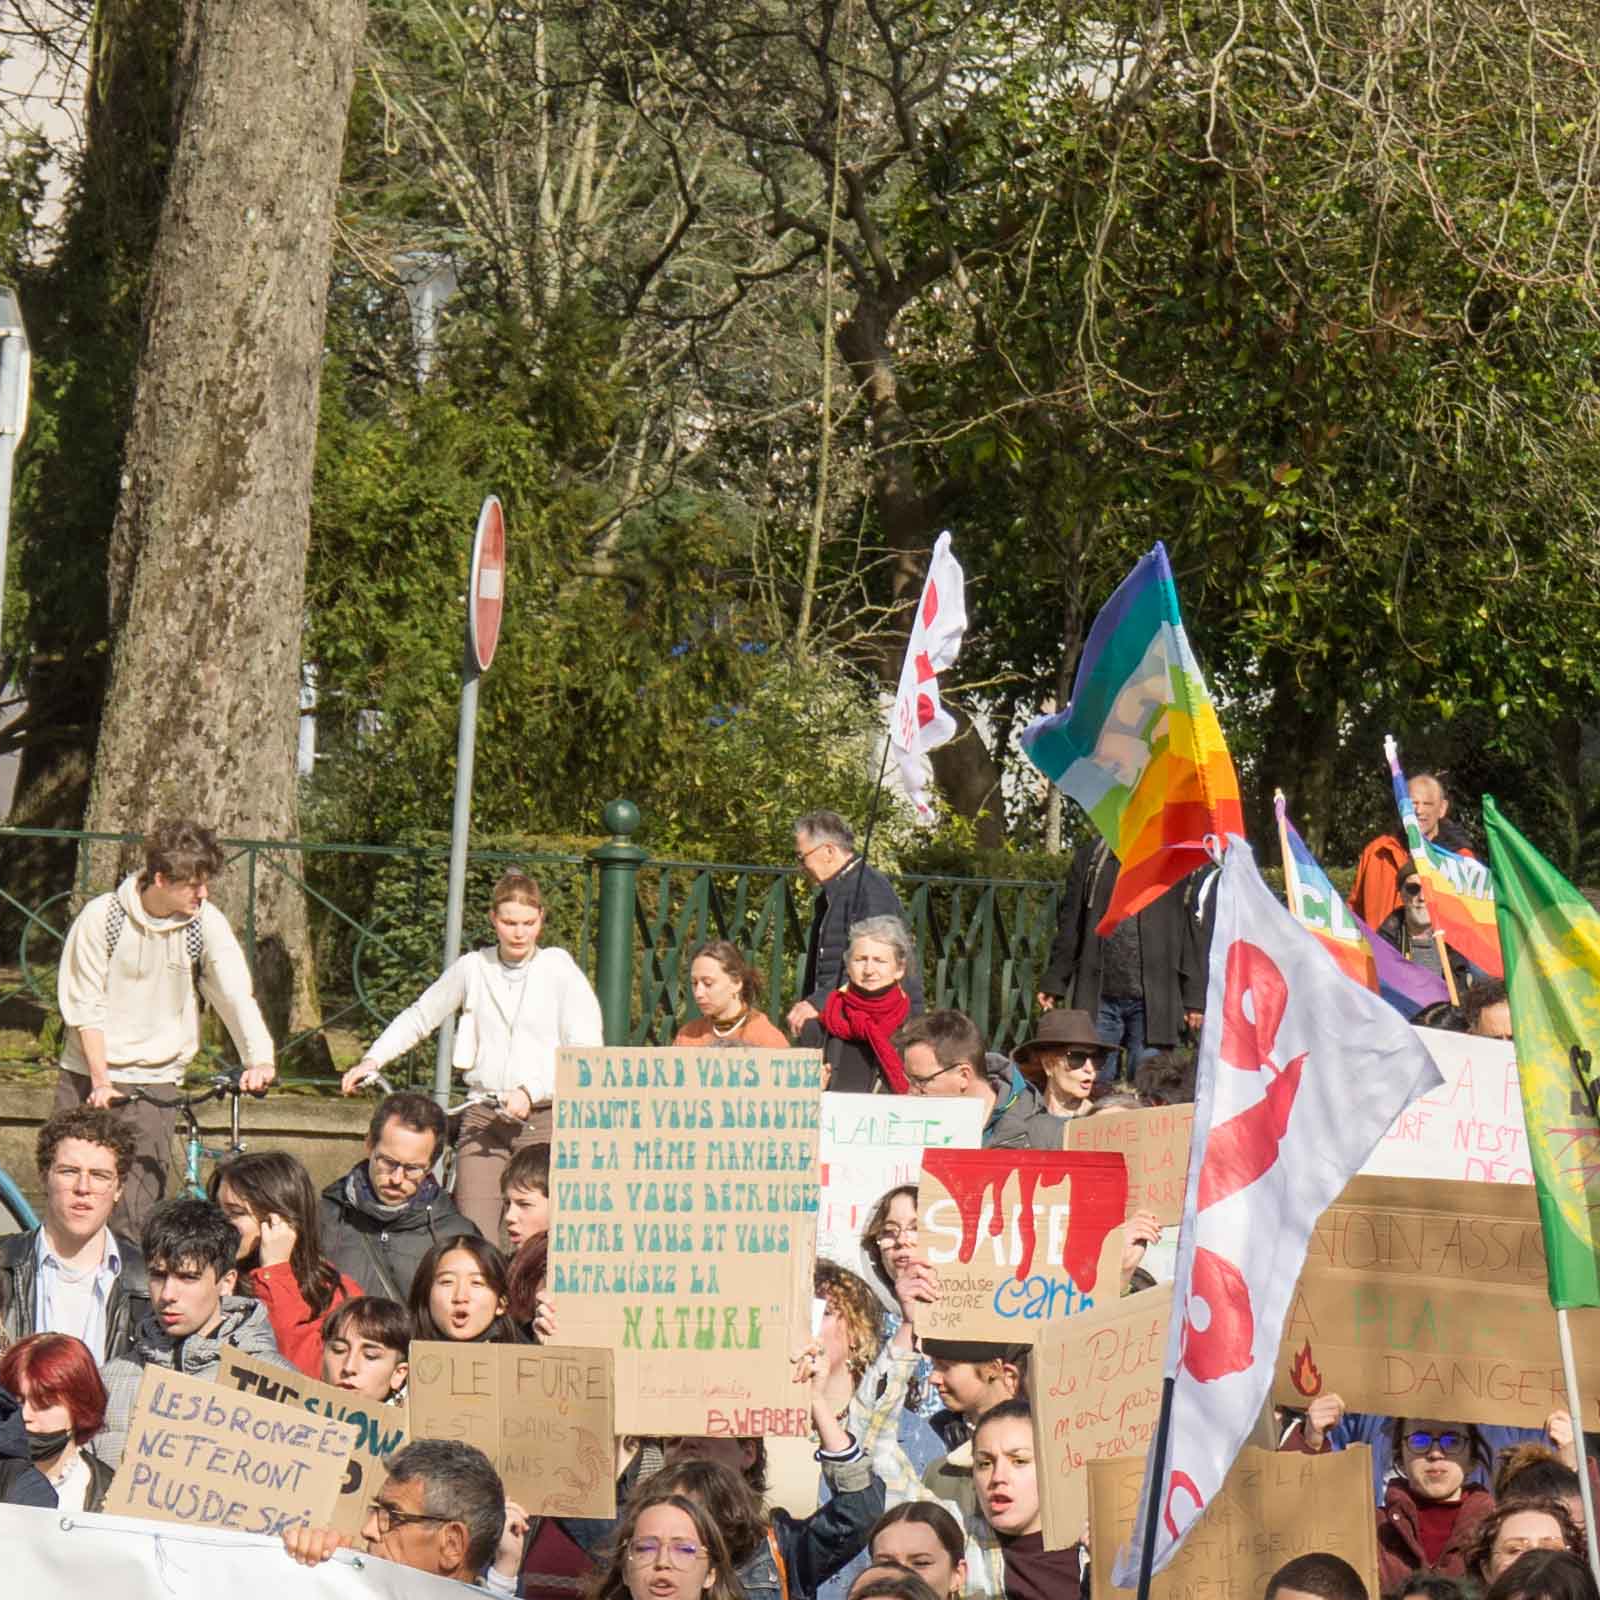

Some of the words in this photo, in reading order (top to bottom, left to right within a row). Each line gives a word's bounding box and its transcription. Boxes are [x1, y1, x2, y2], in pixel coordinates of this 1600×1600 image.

[696, 1057, 761, 1089] VOUS
[770, 1057, 821, 1089] TUEZ
[652, 1100, 714, 1130] VOUS
[555, 1141, 580, 1170] DE
[591, 1141, 620, 1170] LA
[557, 1182, 614, 1212] VOUS
[626, 1182, 694, 1212] VOUS
[554, 1223, 626, 1252] ENTRE
[632, 1223, 694, 1253] VOUS
[701, 1224, 728, 1252] ET
[734, 1223, 791, 1253] VOUS
[689, 1264, 721, 1294] LA
[451, 1358, 493, 1397] LE
[1383, 1355, 1571, 1407] DANGER
